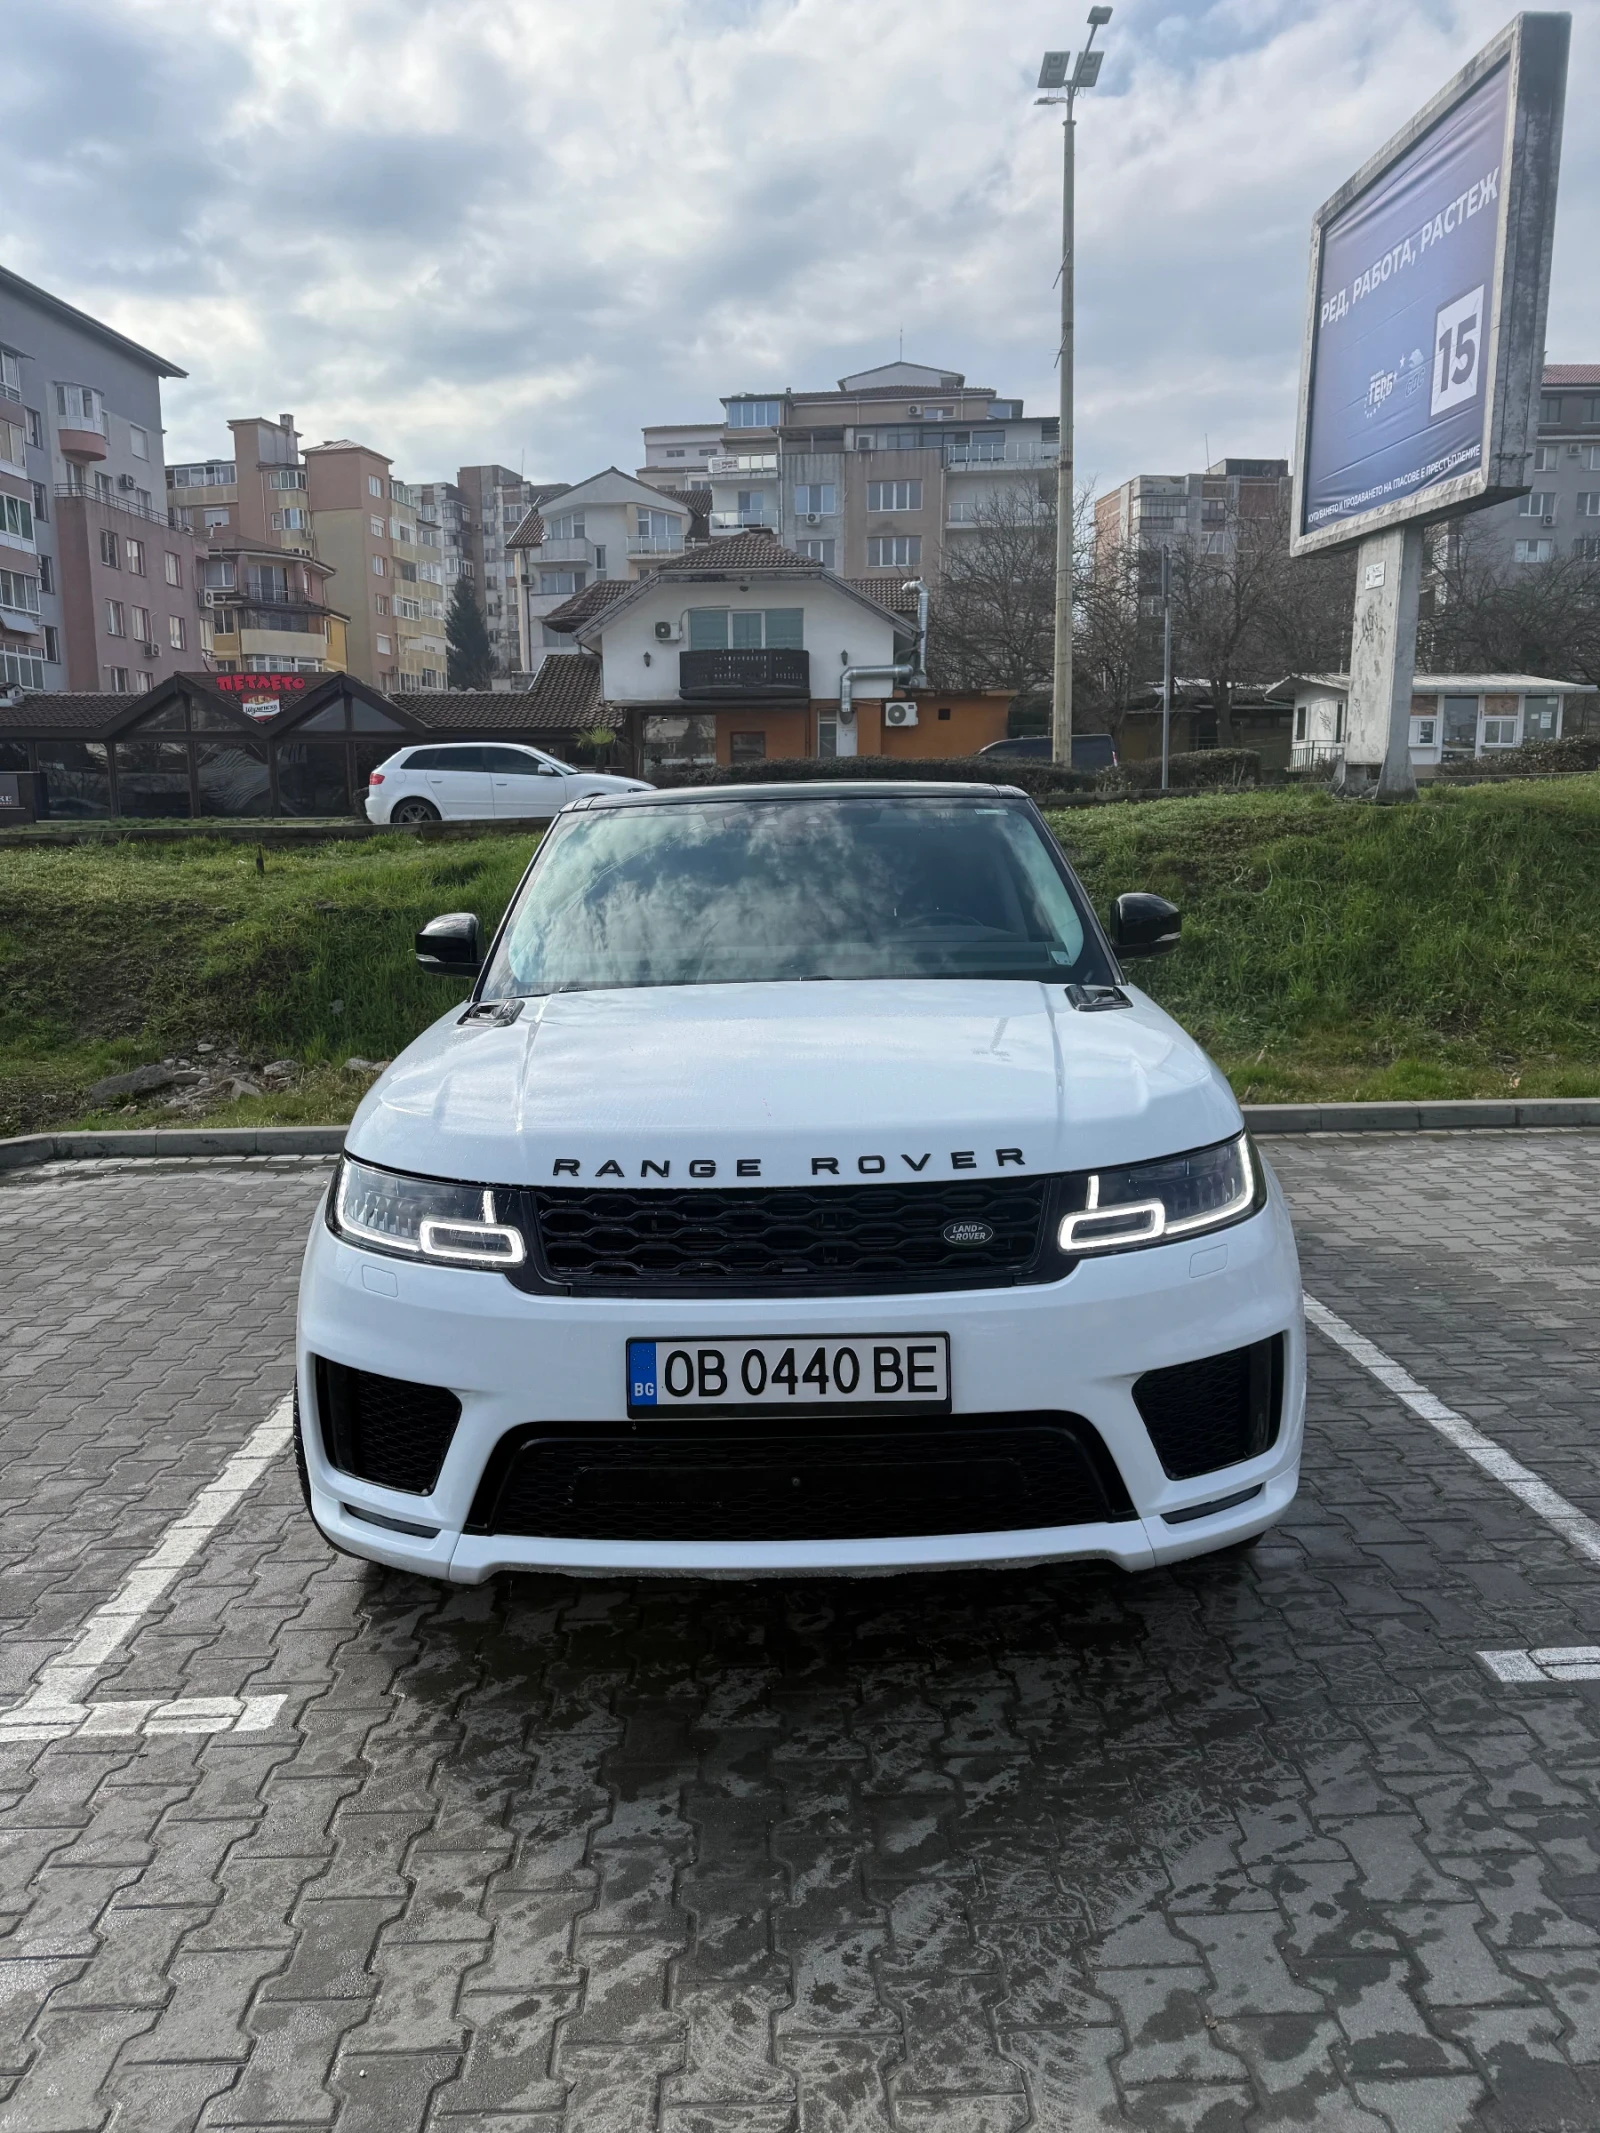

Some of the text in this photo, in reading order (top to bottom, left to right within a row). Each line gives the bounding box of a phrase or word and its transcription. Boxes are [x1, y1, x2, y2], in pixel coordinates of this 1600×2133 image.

[1320, 166, 1500, 328] РЕД, РАБОТА, РАСТЕЖ
[1438, 312, 1478, 393] 15
[1369, 372, 1393, 406] ГЕРБ
[1343, 485, 1383, 509] ПРОДАВАНЕТО
[1383, 481, 1393, 494] НА
[1393, 469, 1421, 490] ГЛАСОВЕ
[1426, 444, 1481, 476] ПРЕСТЪПЛЕНИЕ
[216, 674, 305, 691] ПЕТЛЕТО
[553, 1147, 1026, 1179] RANGE ROVER
[634, 1382, 655, 1397] BG
[664, 1345, 938, 1397] OB 0440 BE
